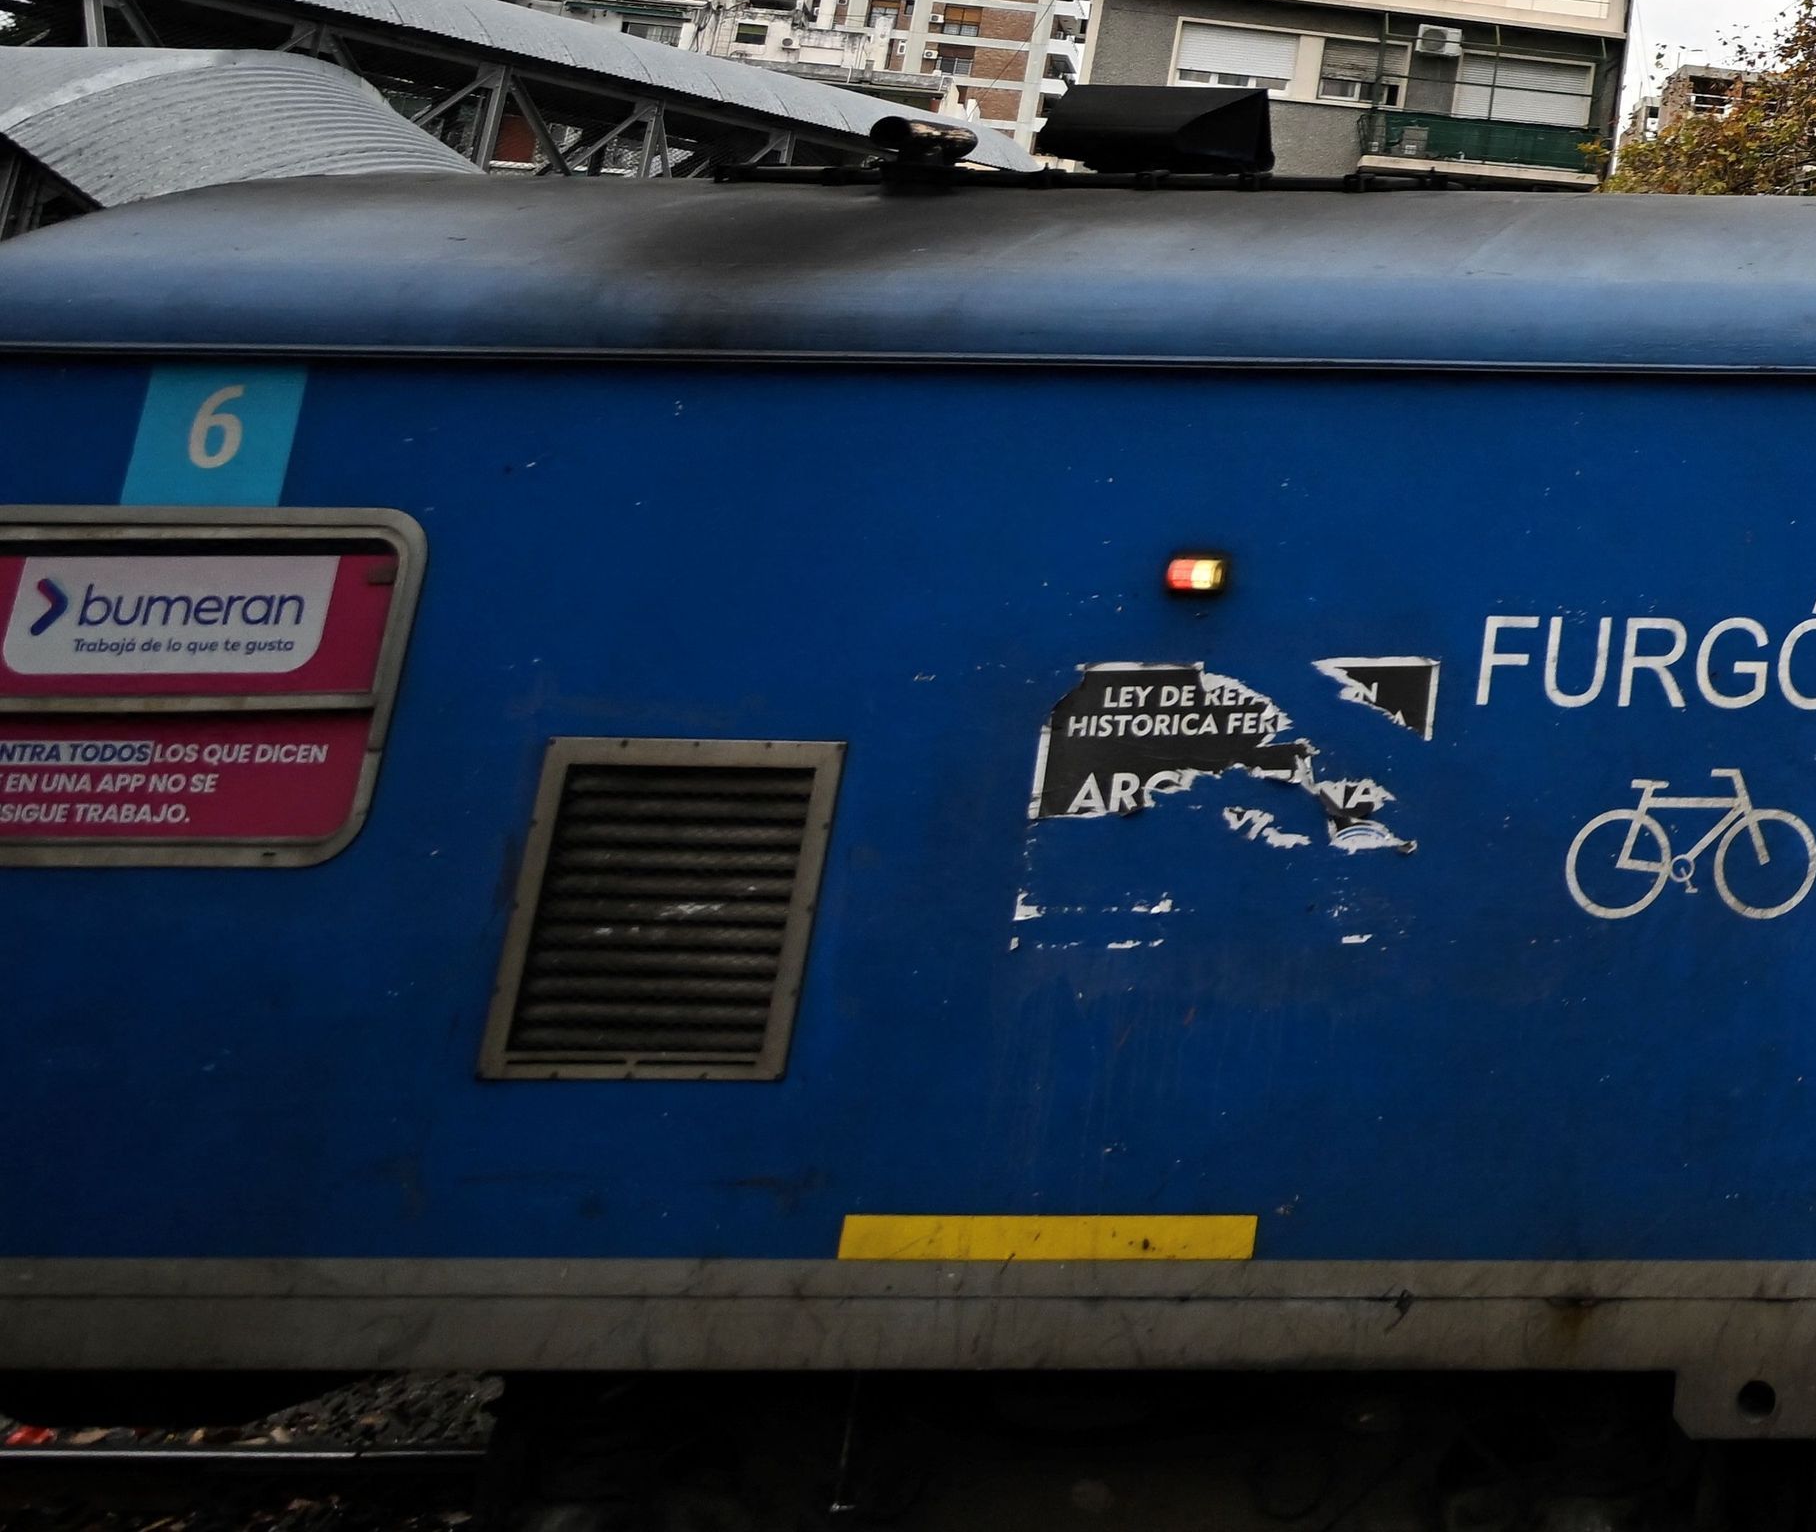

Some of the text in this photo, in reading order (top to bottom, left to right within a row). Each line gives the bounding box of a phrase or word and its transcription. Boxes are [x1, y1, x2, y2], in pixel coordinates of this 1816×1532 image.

[187, 384, 245, 468] 6
[78, 583, 305, 626] bumeran
[73, 637, 295, 656] Trabajá de lo que te gusta
[1104, 685, 1156, 709] LEY
[1160, 685, 1197, 708] DE
[1067, 714, 1218, 738] HISTORICA
[69, 743, 150, 763] TODOS
[153, 744, 198, 764] LOS
[203, 744, 250, 767] QUE
[254, 744, 328, 763] DICEN
[5, 773, 219, 793] EN UNA APP NO SE
[75, 803, 190, 824] TRABAJO.
